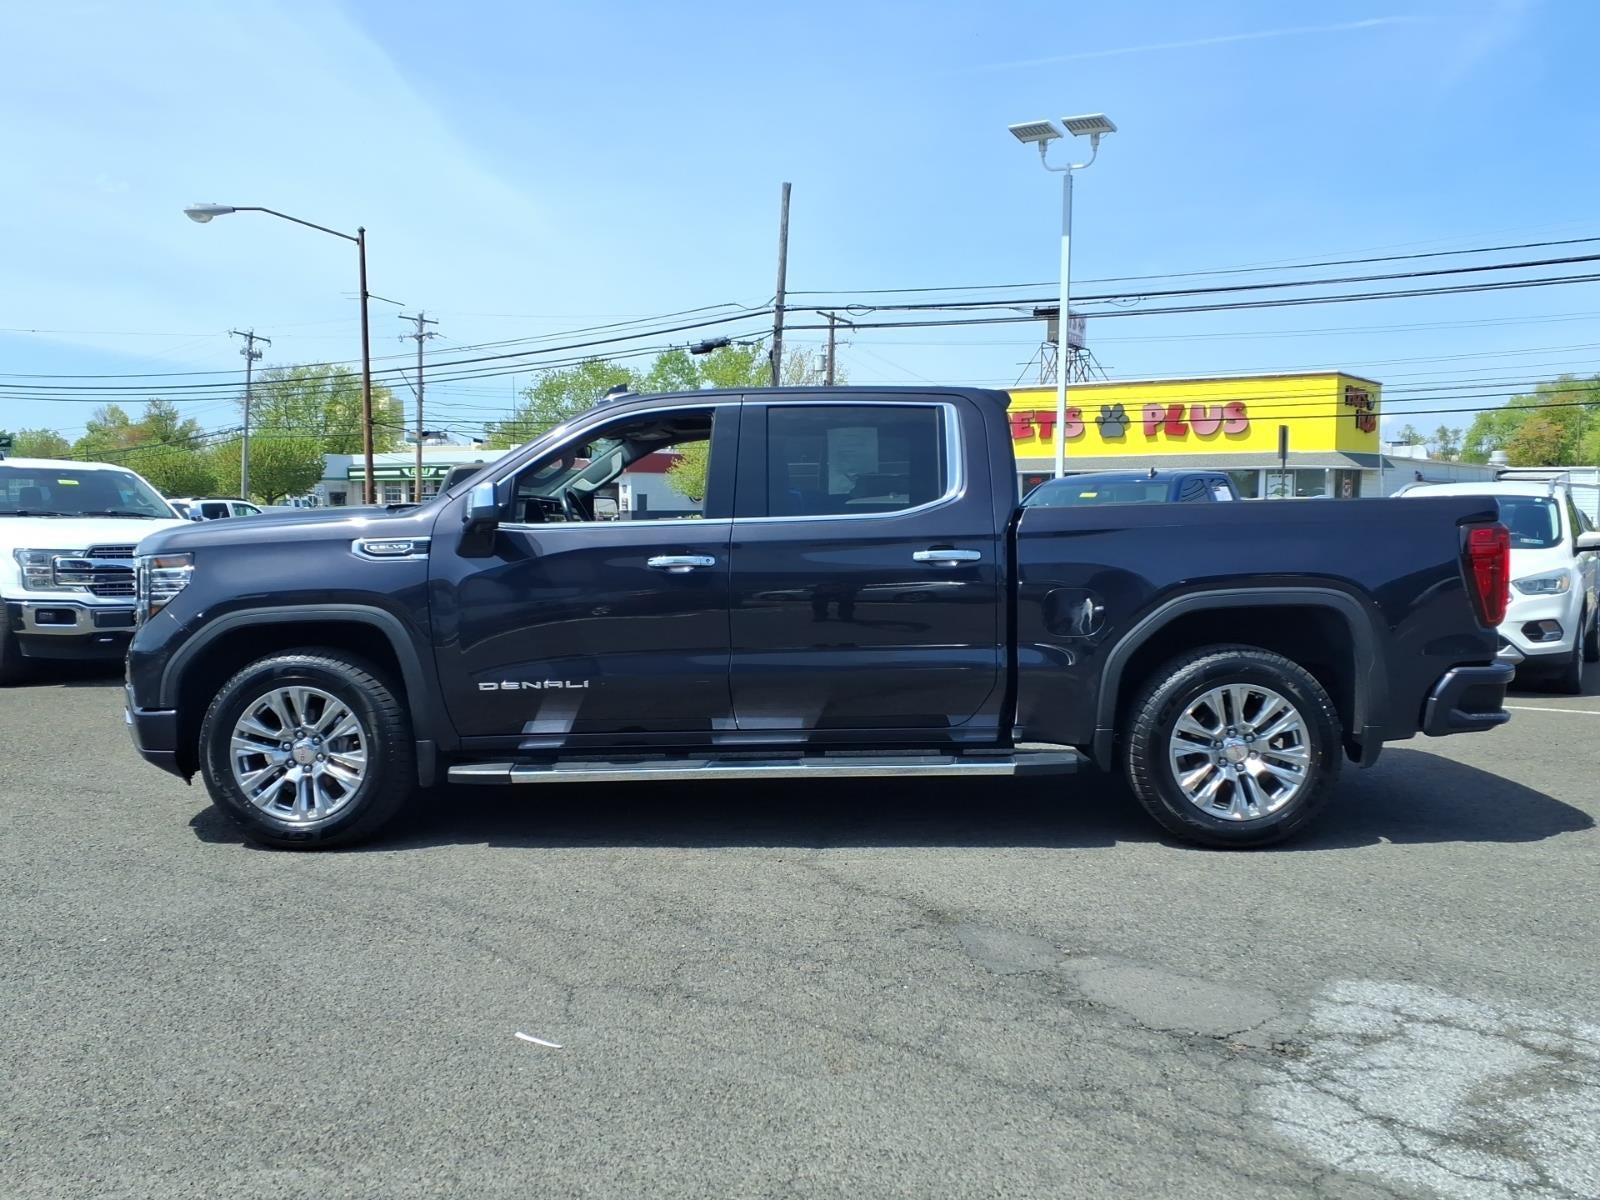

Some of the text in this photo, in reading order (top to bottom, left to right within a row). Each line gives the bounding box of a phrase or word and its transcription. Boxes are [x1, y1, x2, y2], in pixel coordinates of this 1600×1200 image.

[1009, 402, 1249, 439] ETS PLUS
[478, 680, 589, 691] DENALI
